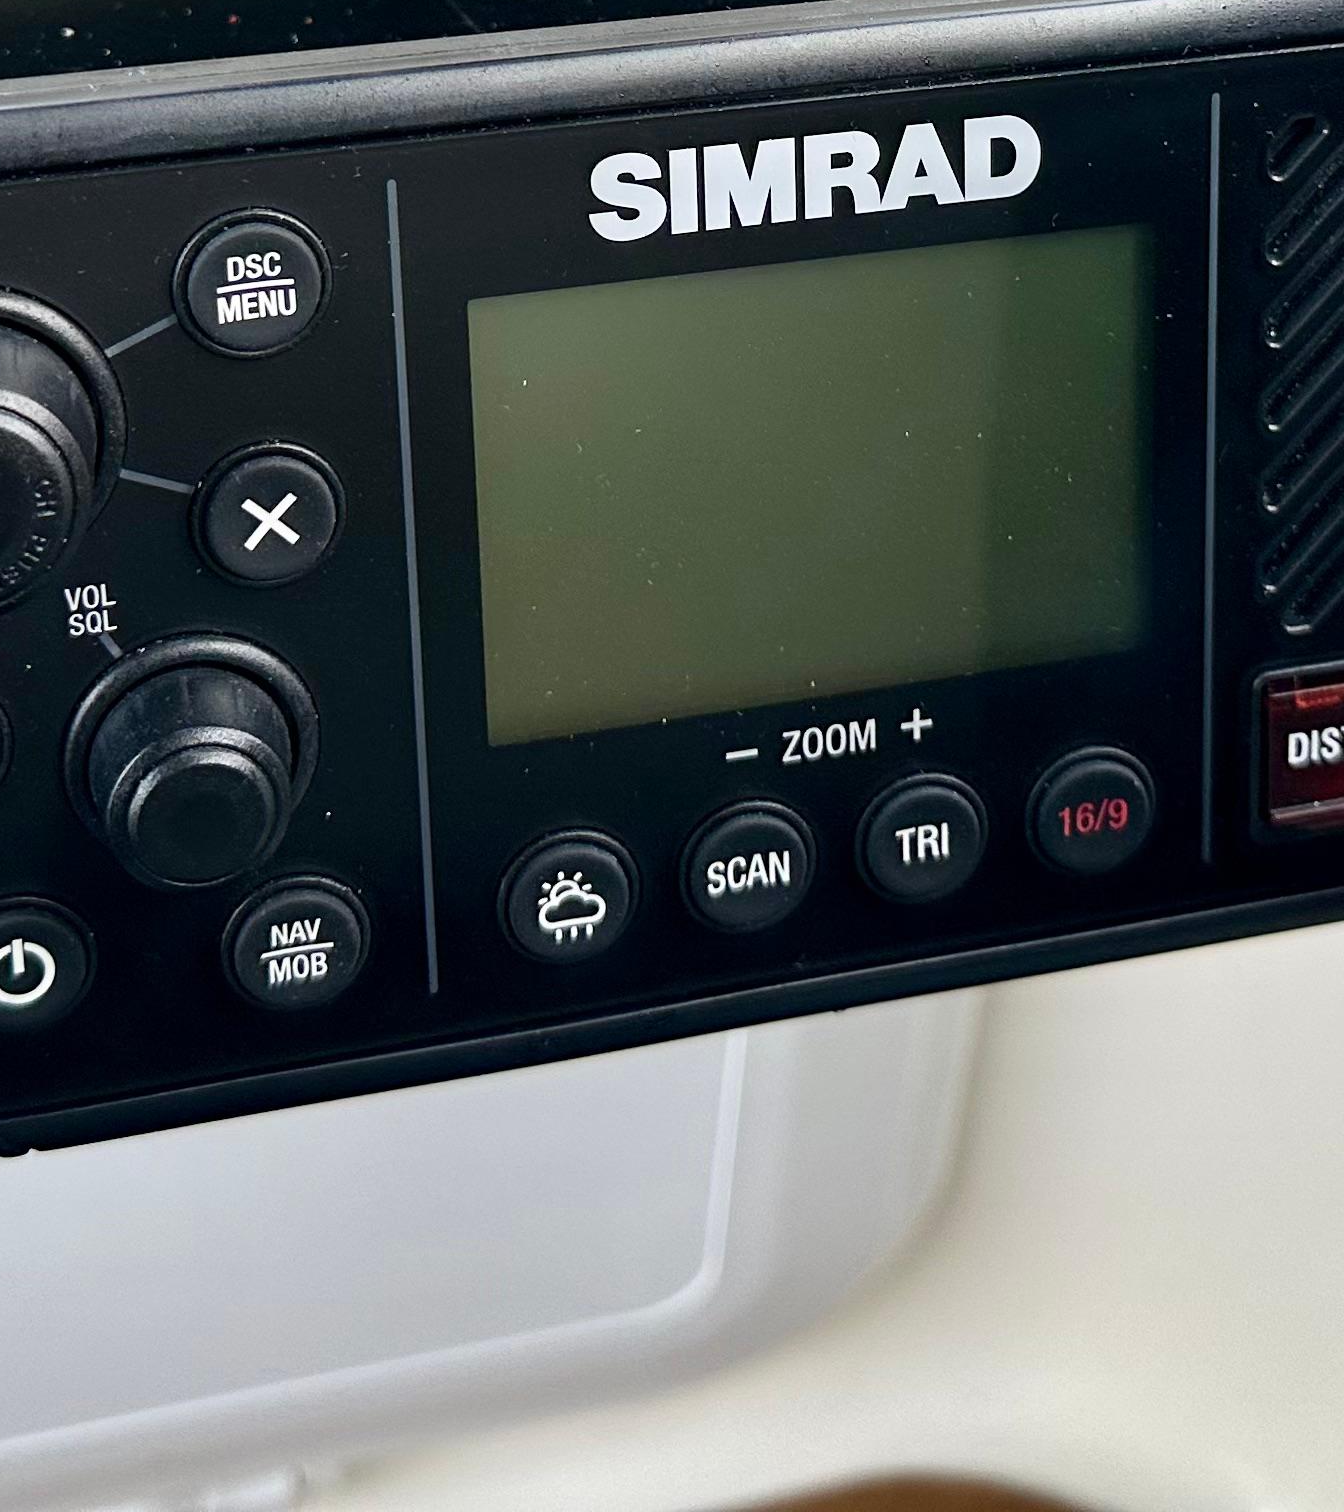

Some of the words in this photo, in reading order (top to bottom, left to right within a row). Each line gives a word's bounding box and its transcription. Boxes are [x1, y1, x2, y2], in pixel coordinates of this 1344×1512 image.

[588, 114, 1042, 242] SIMRAD
[226, 251, 282, 282] DSC
[216, 285, 297, 325] MENU
[64, 583, 117, 611] VOL
[68, 609, 118, 636] SQL
[782, 718, 876, 763] ZOOM
[1061, 799, 1129, 837] 16/9
[895, 822, 950, 864] TRI
[707, 850, 791, 897] SCAN
[270, 918, 321, 947] NAV
[267, 952, 329, 985] MOB
